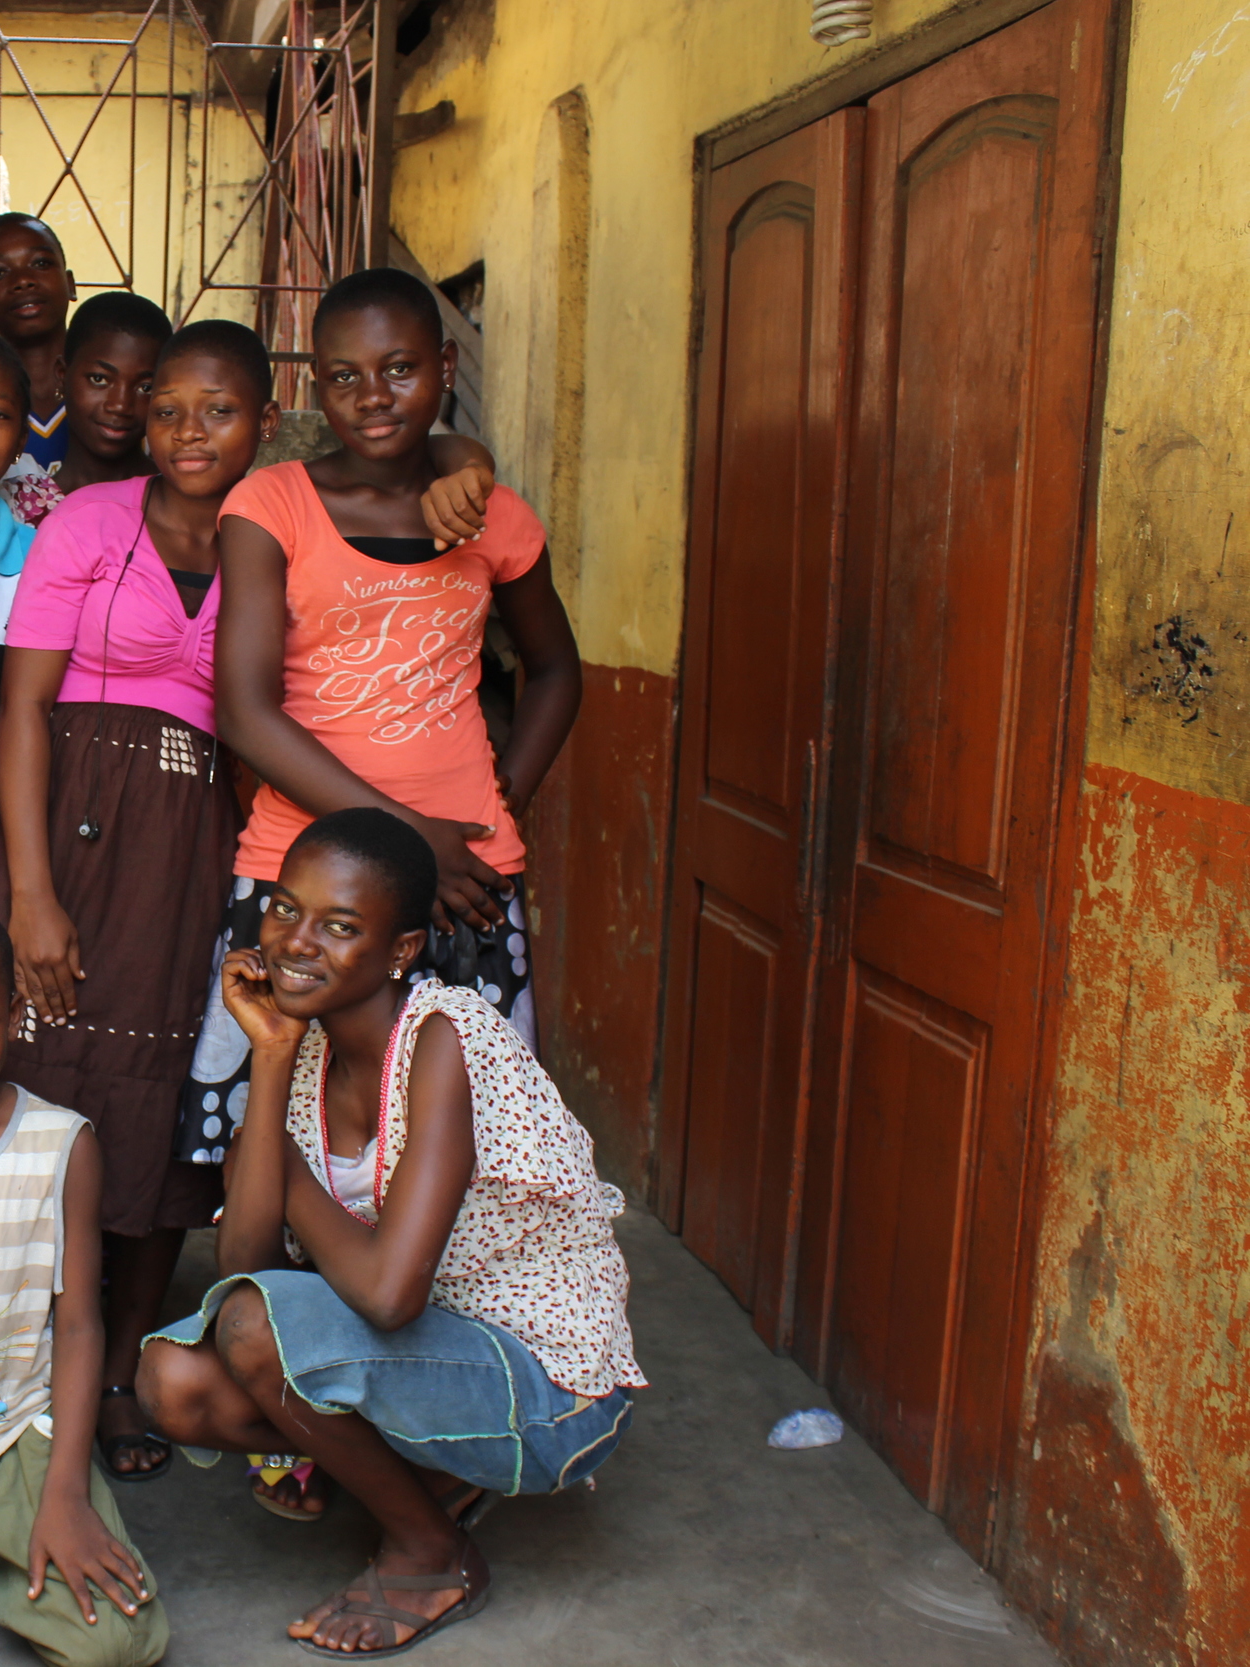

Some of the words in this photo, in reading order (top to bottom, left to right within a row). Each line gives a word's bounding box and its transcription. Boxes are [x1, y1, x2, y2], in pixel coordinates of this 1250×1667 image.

[338, 572, 437, 605] Number
[442, 571, 483, 595] One
[320, 590, 488, 664] Torch
